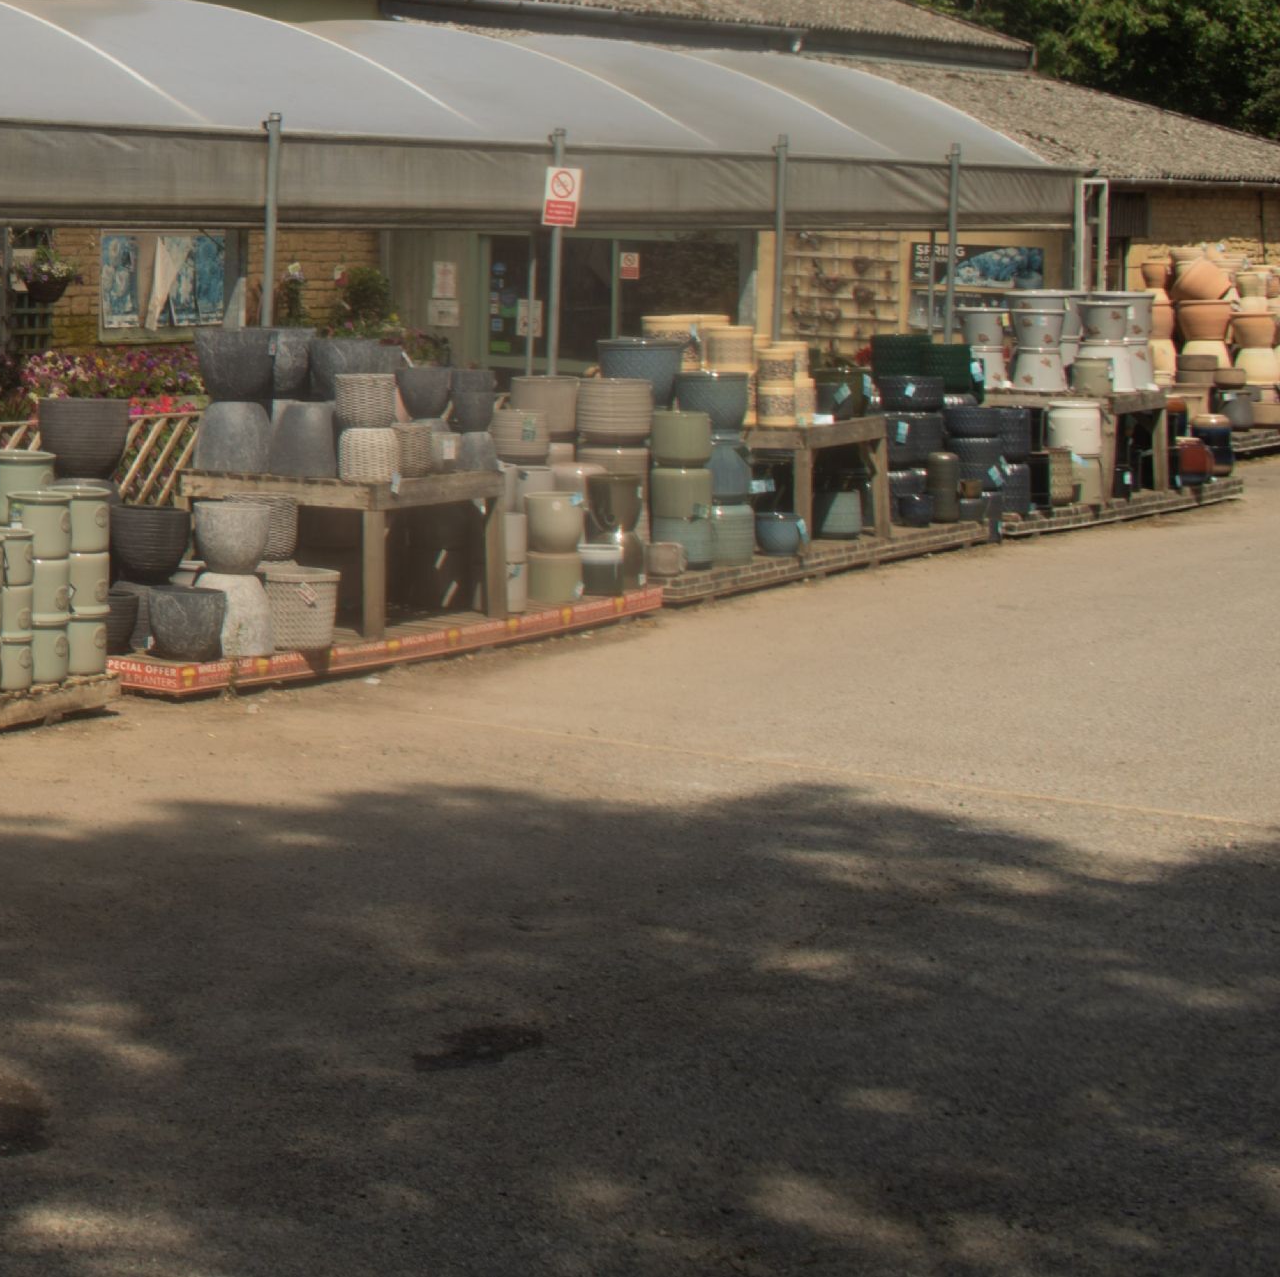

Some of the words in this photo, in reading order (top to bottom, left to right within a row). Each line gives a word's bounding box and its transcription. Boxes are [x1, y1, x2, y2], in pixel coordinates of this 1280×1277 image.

[916, 244, 966, 257] SPRIG
[107, 659, 143, 673] PECIAL
[144, 665, 177, 676] OFFER
[133, 673, 178, 688] PLANTERS
